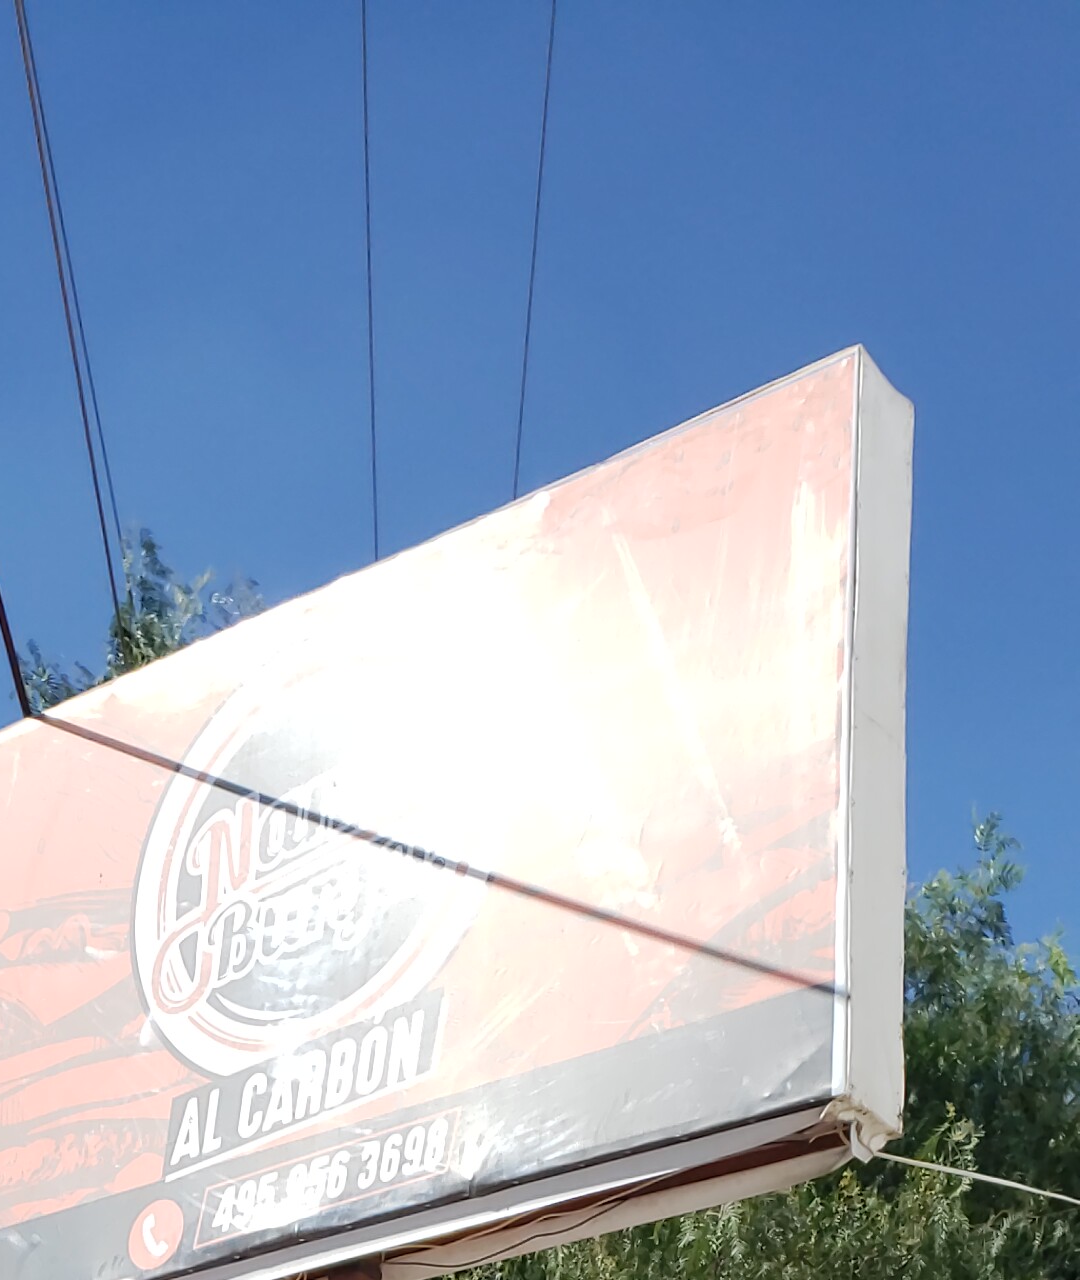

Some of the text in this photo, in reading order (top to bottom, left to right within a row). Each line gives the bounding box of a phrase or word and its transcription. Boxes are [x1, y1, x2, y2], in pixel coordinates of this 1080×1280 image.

[169, 1009, 425, 1167] AL CARBÓN
[357, 1116, 449, 1191] 3698
